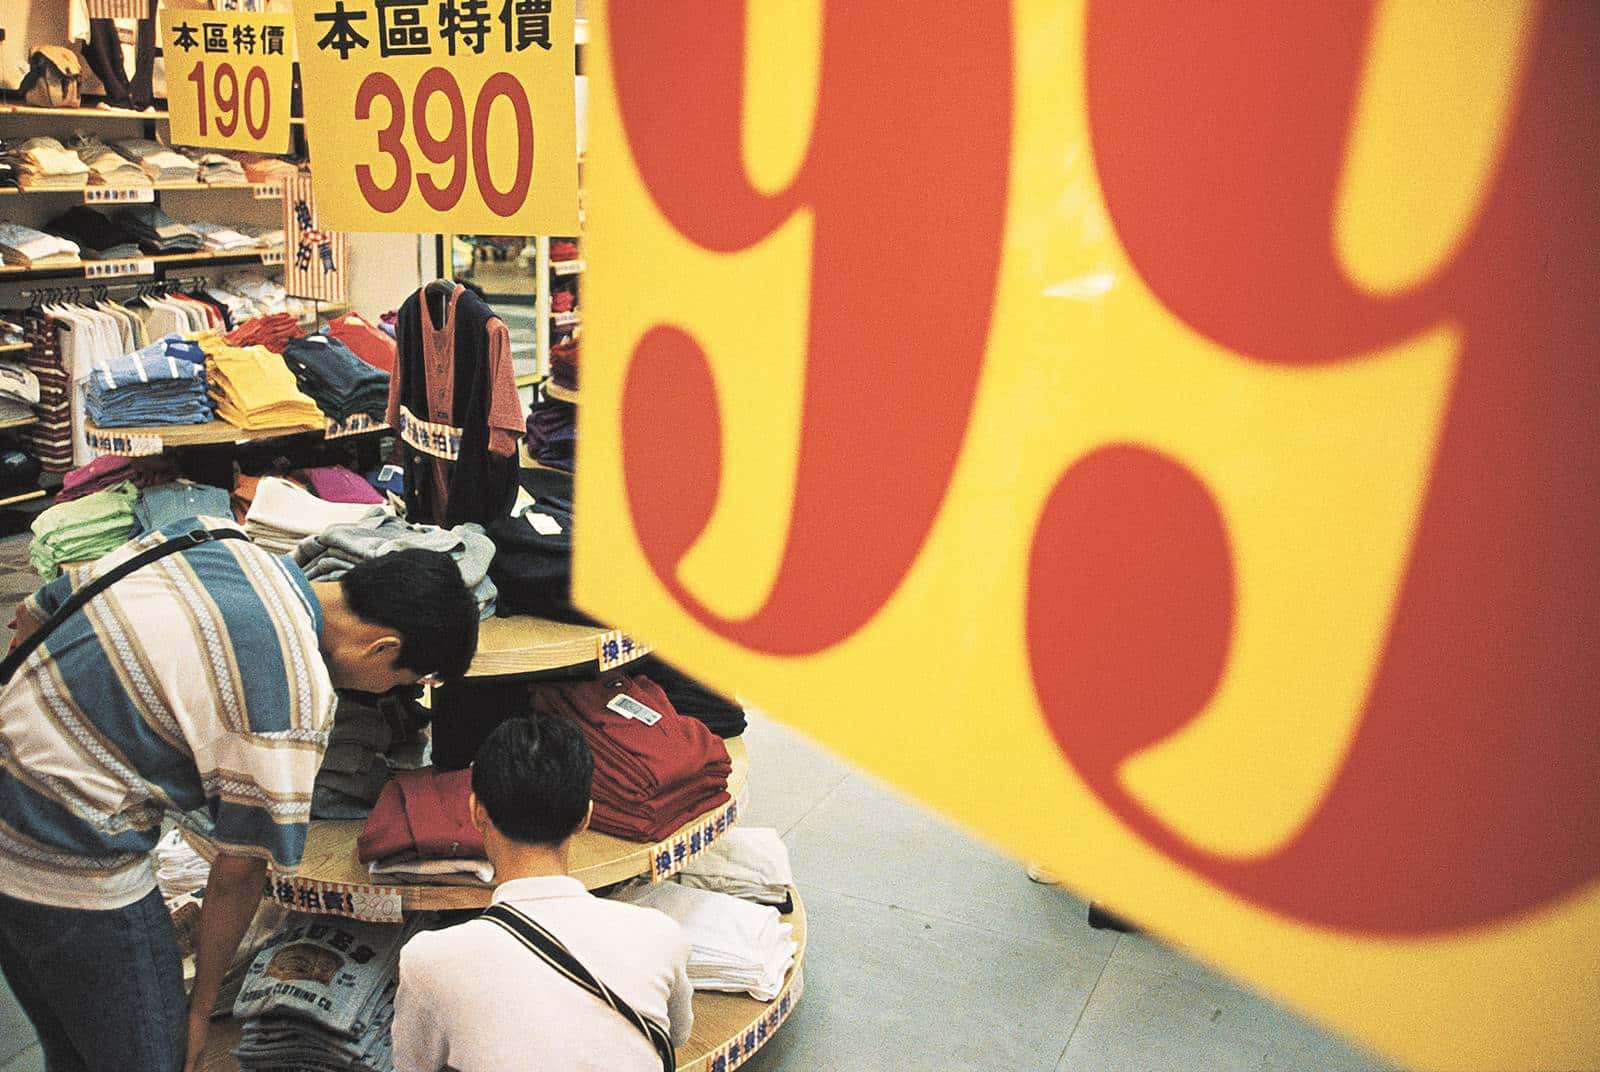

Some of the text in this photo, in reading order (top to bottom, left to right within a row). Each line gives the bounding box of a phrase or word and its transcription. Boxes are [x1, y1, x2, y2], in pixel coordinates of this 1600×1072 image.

[172, 21, 284, 55] 本區特價
[315, 0, 552, 59] 本區特價
[188, 61, 271, 140] 190
[355, 66, 534, 217] 390
